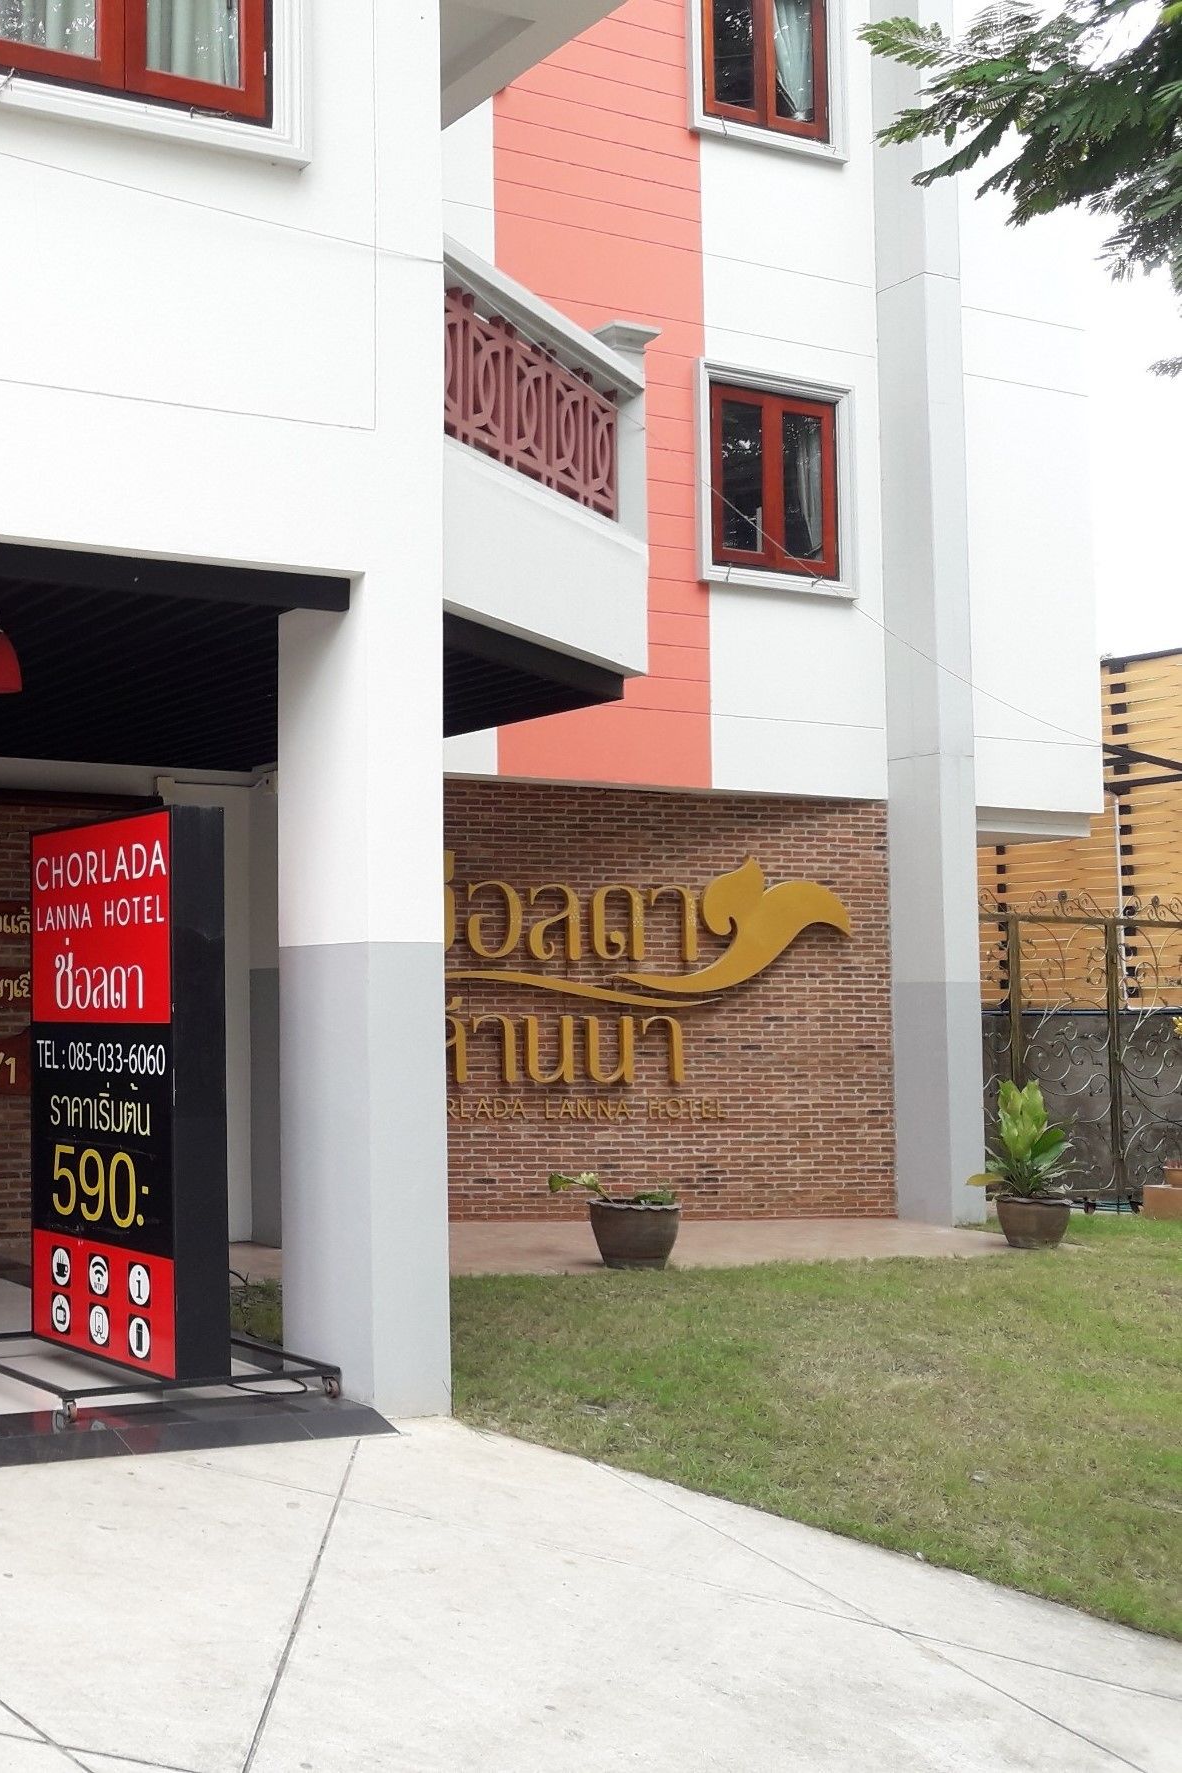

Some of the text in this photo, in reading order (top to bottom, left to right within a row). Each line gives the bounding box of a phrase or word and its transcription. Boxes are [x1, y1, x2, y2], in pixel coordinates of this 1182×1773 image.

[35, 840, 167, 891] CHORLADA
[37, 894, 165, 932] LANNA HOTEL
[443, 849, 700, 961] อลดา
[67, 1041, 166, 1076] 085-033-6060
[50, 1081, 151, 1137] ราคาเริ่มต้น
[544, 1096, 631, 1120] LANNA
[647, 1096, 729, 1120] HOTEL
